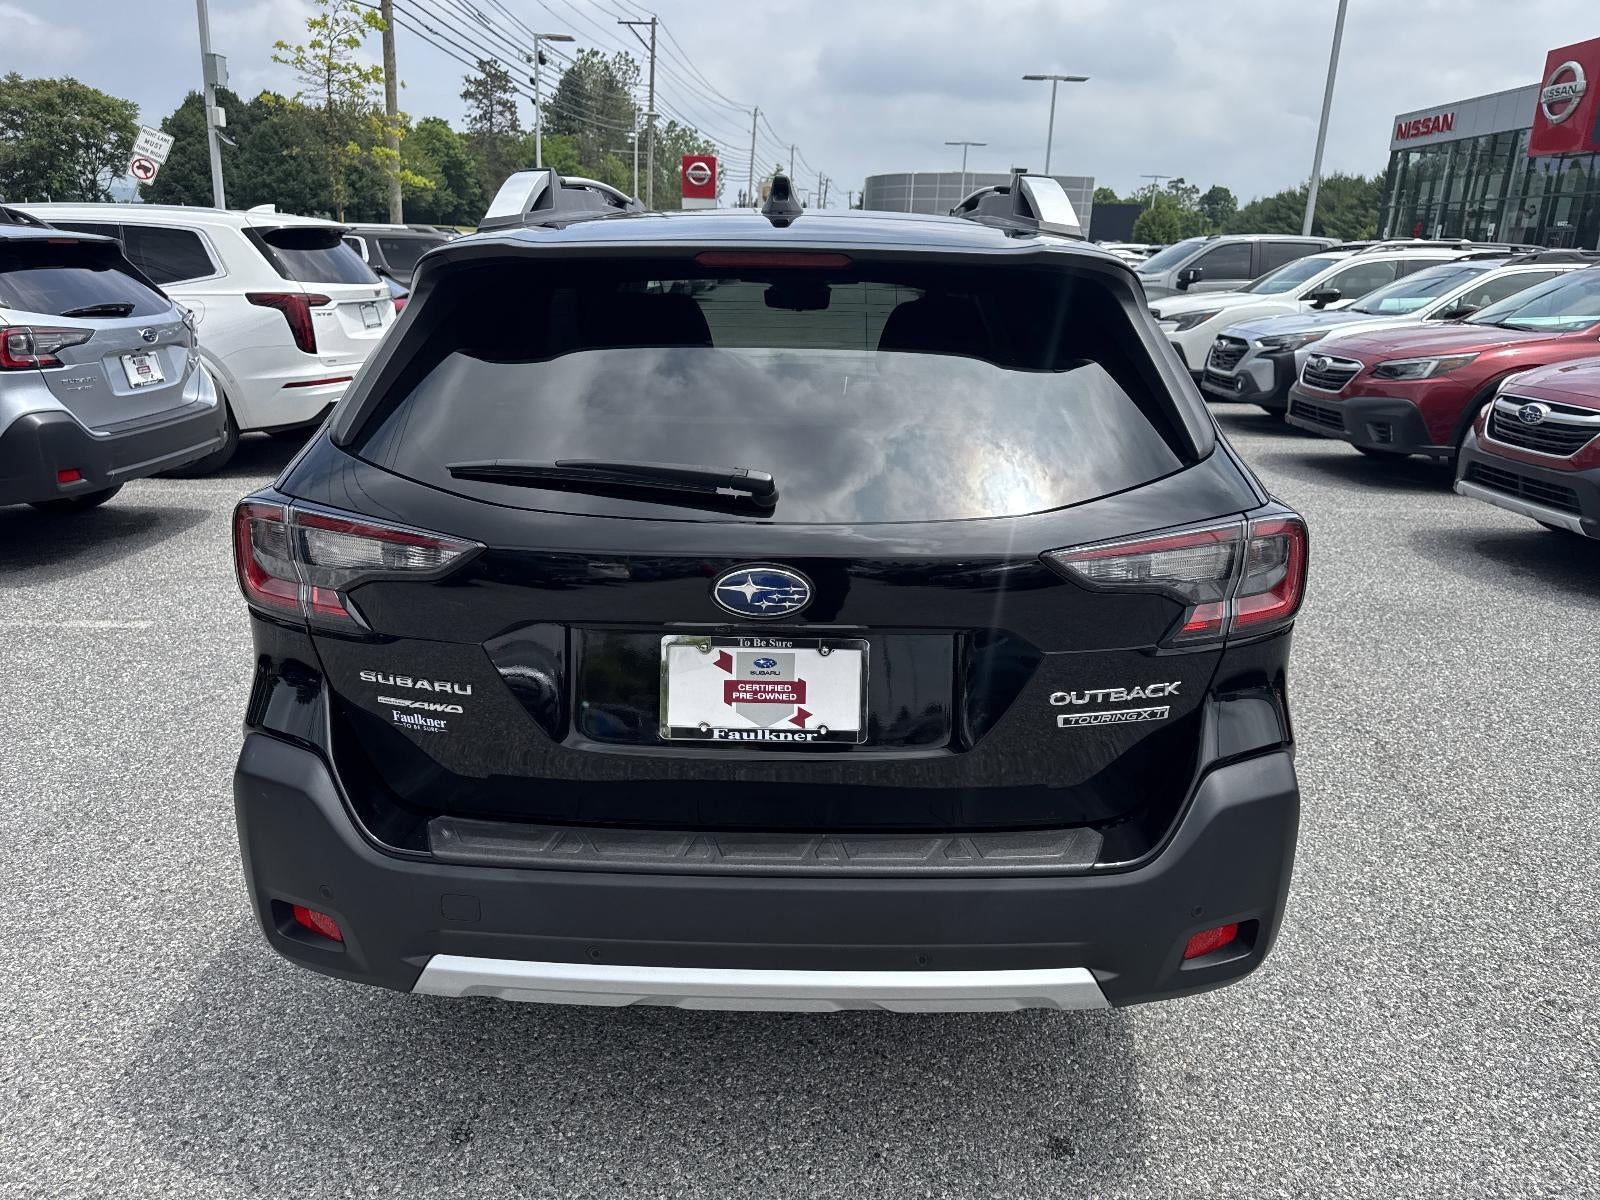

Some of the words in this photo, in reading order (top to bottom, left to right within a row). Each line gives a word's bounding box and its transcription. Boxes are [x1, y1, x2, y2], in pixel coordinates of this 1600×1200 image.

[1395, 112, 1455, 141] NISSAN
[142, 129, 157, 138] RIGHT
[157, 133, 171, 144] LANE
[144, 138, 163, 150] MUST
[136, 143, 150, 153] TURN
[149, 150, 166, 160] RIGHT
[738, 638, 751, 647] To
[753, 638, 767, 647] Be
[769, 638, 793, 648] Sure
[359, 670, 472, 695] SUBARU
[737, 683, 792, 692] CERTIFIED
[732, 692, 797, 701] PRE-OWNED
[1049, 681, 1182, 706] OUTBACK
[408, 702, 464, 713] AWD
[392, 710, 447, 727] Faulkner
[1068, 712, 1138, 725] TOURING
[1137, 708, 1167, 719] XT
[712, 728, 818, 741] Faulkner
